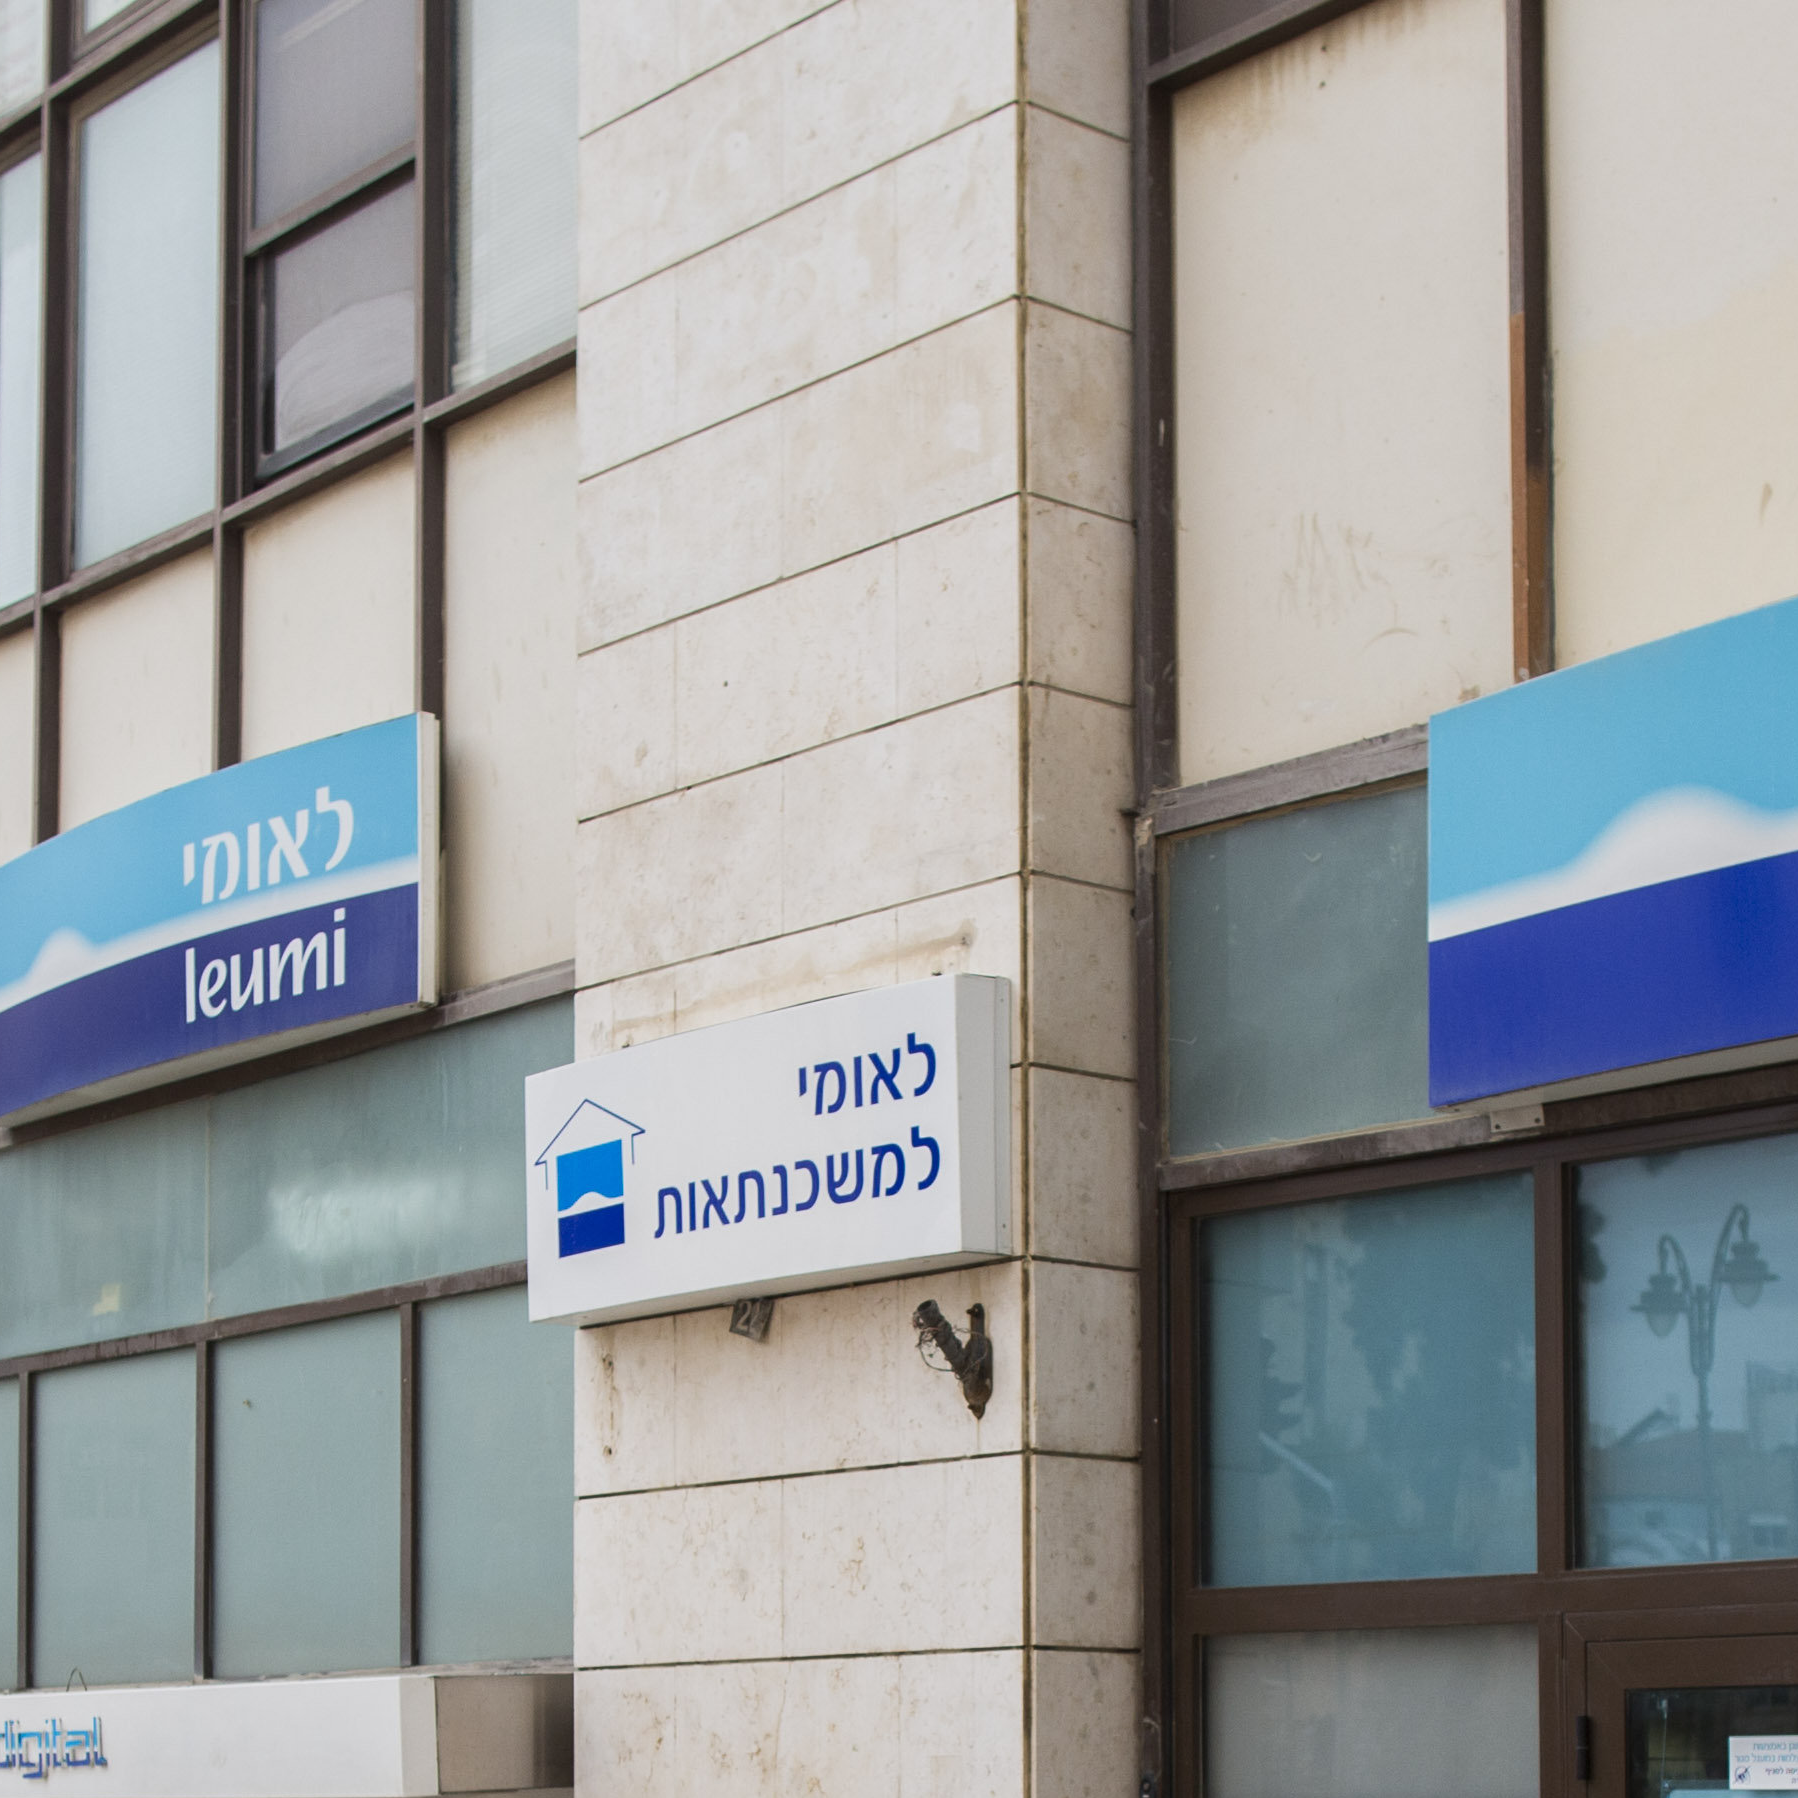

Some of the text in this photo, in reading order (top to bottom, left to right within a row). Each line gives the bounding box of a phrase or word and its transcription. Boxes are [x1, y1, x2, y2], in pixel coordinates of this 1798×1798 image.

[183, 786, 354, 905] לאומי
[185, 907, 345, 1024] leumi
[799, 1032, 936, 1116] לאומי
[654, 1126, 941, 1239] למשכנתאות
